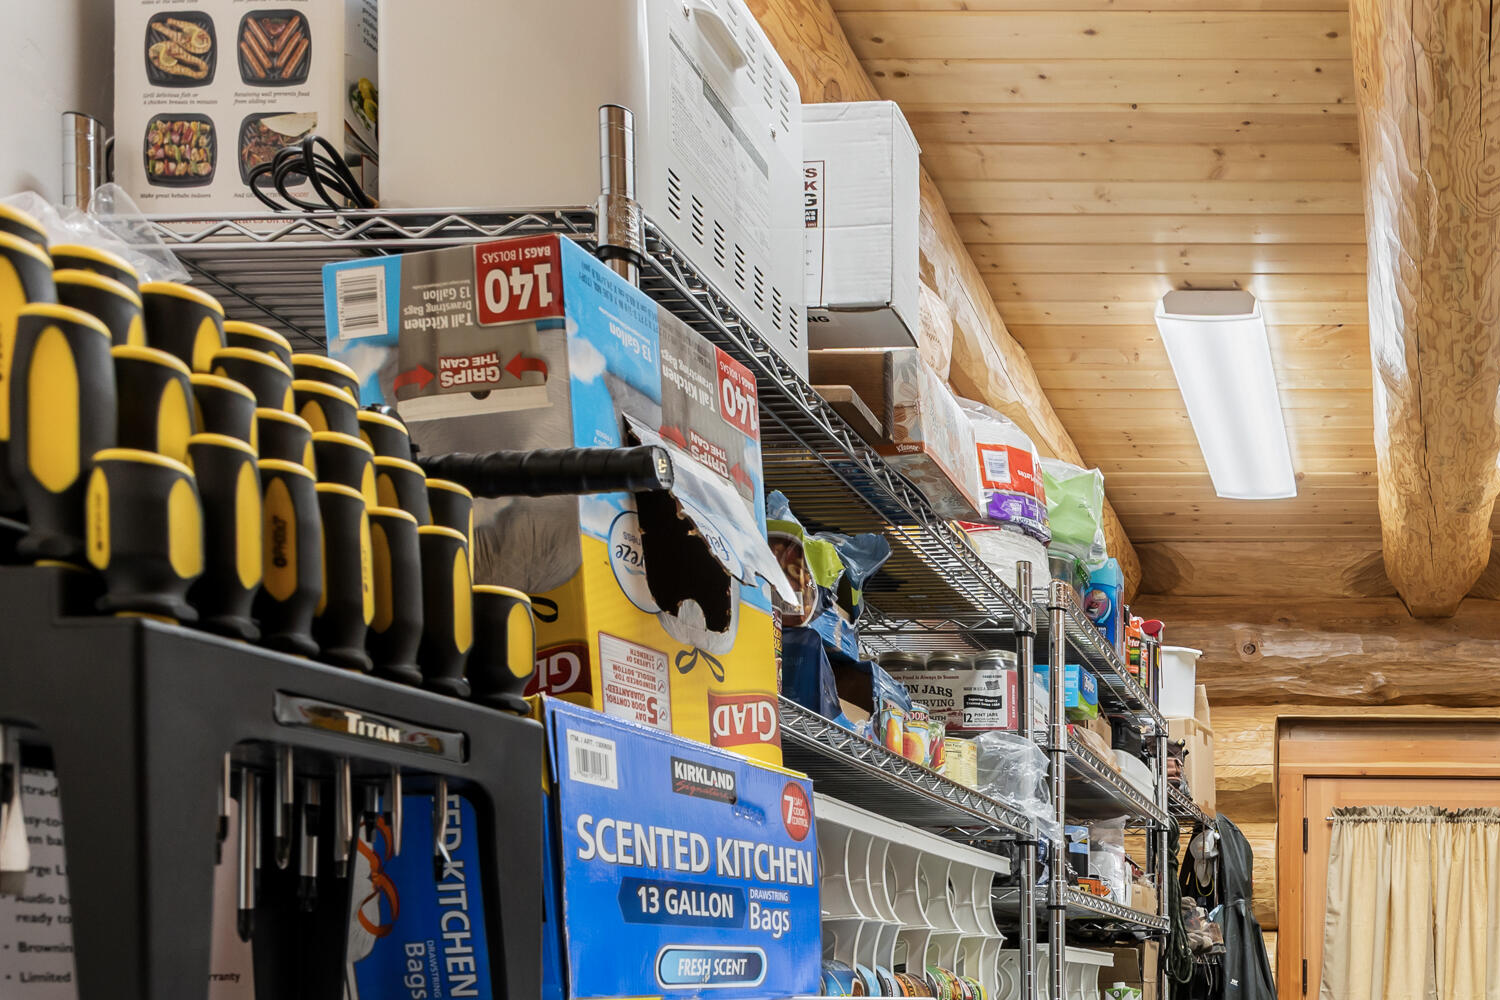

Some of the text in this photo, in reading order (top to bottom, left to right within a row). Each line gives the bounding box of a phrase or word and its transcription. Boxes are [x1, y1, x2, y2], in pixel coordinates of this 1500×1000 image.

[482, 246, 551, 264] BAGS BOLSAS
[422, 286, 472, 300] 13 Gallon
[484, 263, 553, 314] 140
[404, 300, 472, 316] Drawstring Bags
[404, 313, 474, 331] Tall Kitchen
[608, 320, 640, 354] Gallon
[440, 353, 499, 368] THE CAN
[440, 366, 501, 388] GRIPS
[661, 363, 716, 412] Tall Kitchen
[722, 378, 757, 432] 140
[689, 430, 728, 462] THE CAN
[535, 651, 581, 694] GL
[606, 693, 646, 711] ODOR CONTROL
[921, 684, 953, 698] JARS
[635, 711, 647, 722] DAY
[646, 696, 658, 726] 5
[713, 700, 777, 741] GLAD
[963, 712, 973, 723] 12
[343, 710, 402, 744] TITAN
[673, 760, 735, 792] KIRKLAND
[783, 794, 795, 826] 7
[576, 813, 710, 874] SCENTED
[716, 836, 815, 887] KITCHEN
[14, 894, 55, 905] Audio
[636, 885, 735, 919] 13 GALLON
[748, 887, 790, 903] DRAWSTRING
[15, 912, 53, 925] ready
[436, 859, 479, 998] KITCHEN
[749, 902, 791, 939] Bags
[18, 941, 74, 954] Brownin
[20, 972, 72, 984] Limited
[403, 942, 428, 1000] Bags
[426, 939, 442, 999] DRAWSTRING
[677, 958, 748, 977] FRESH SCENT
